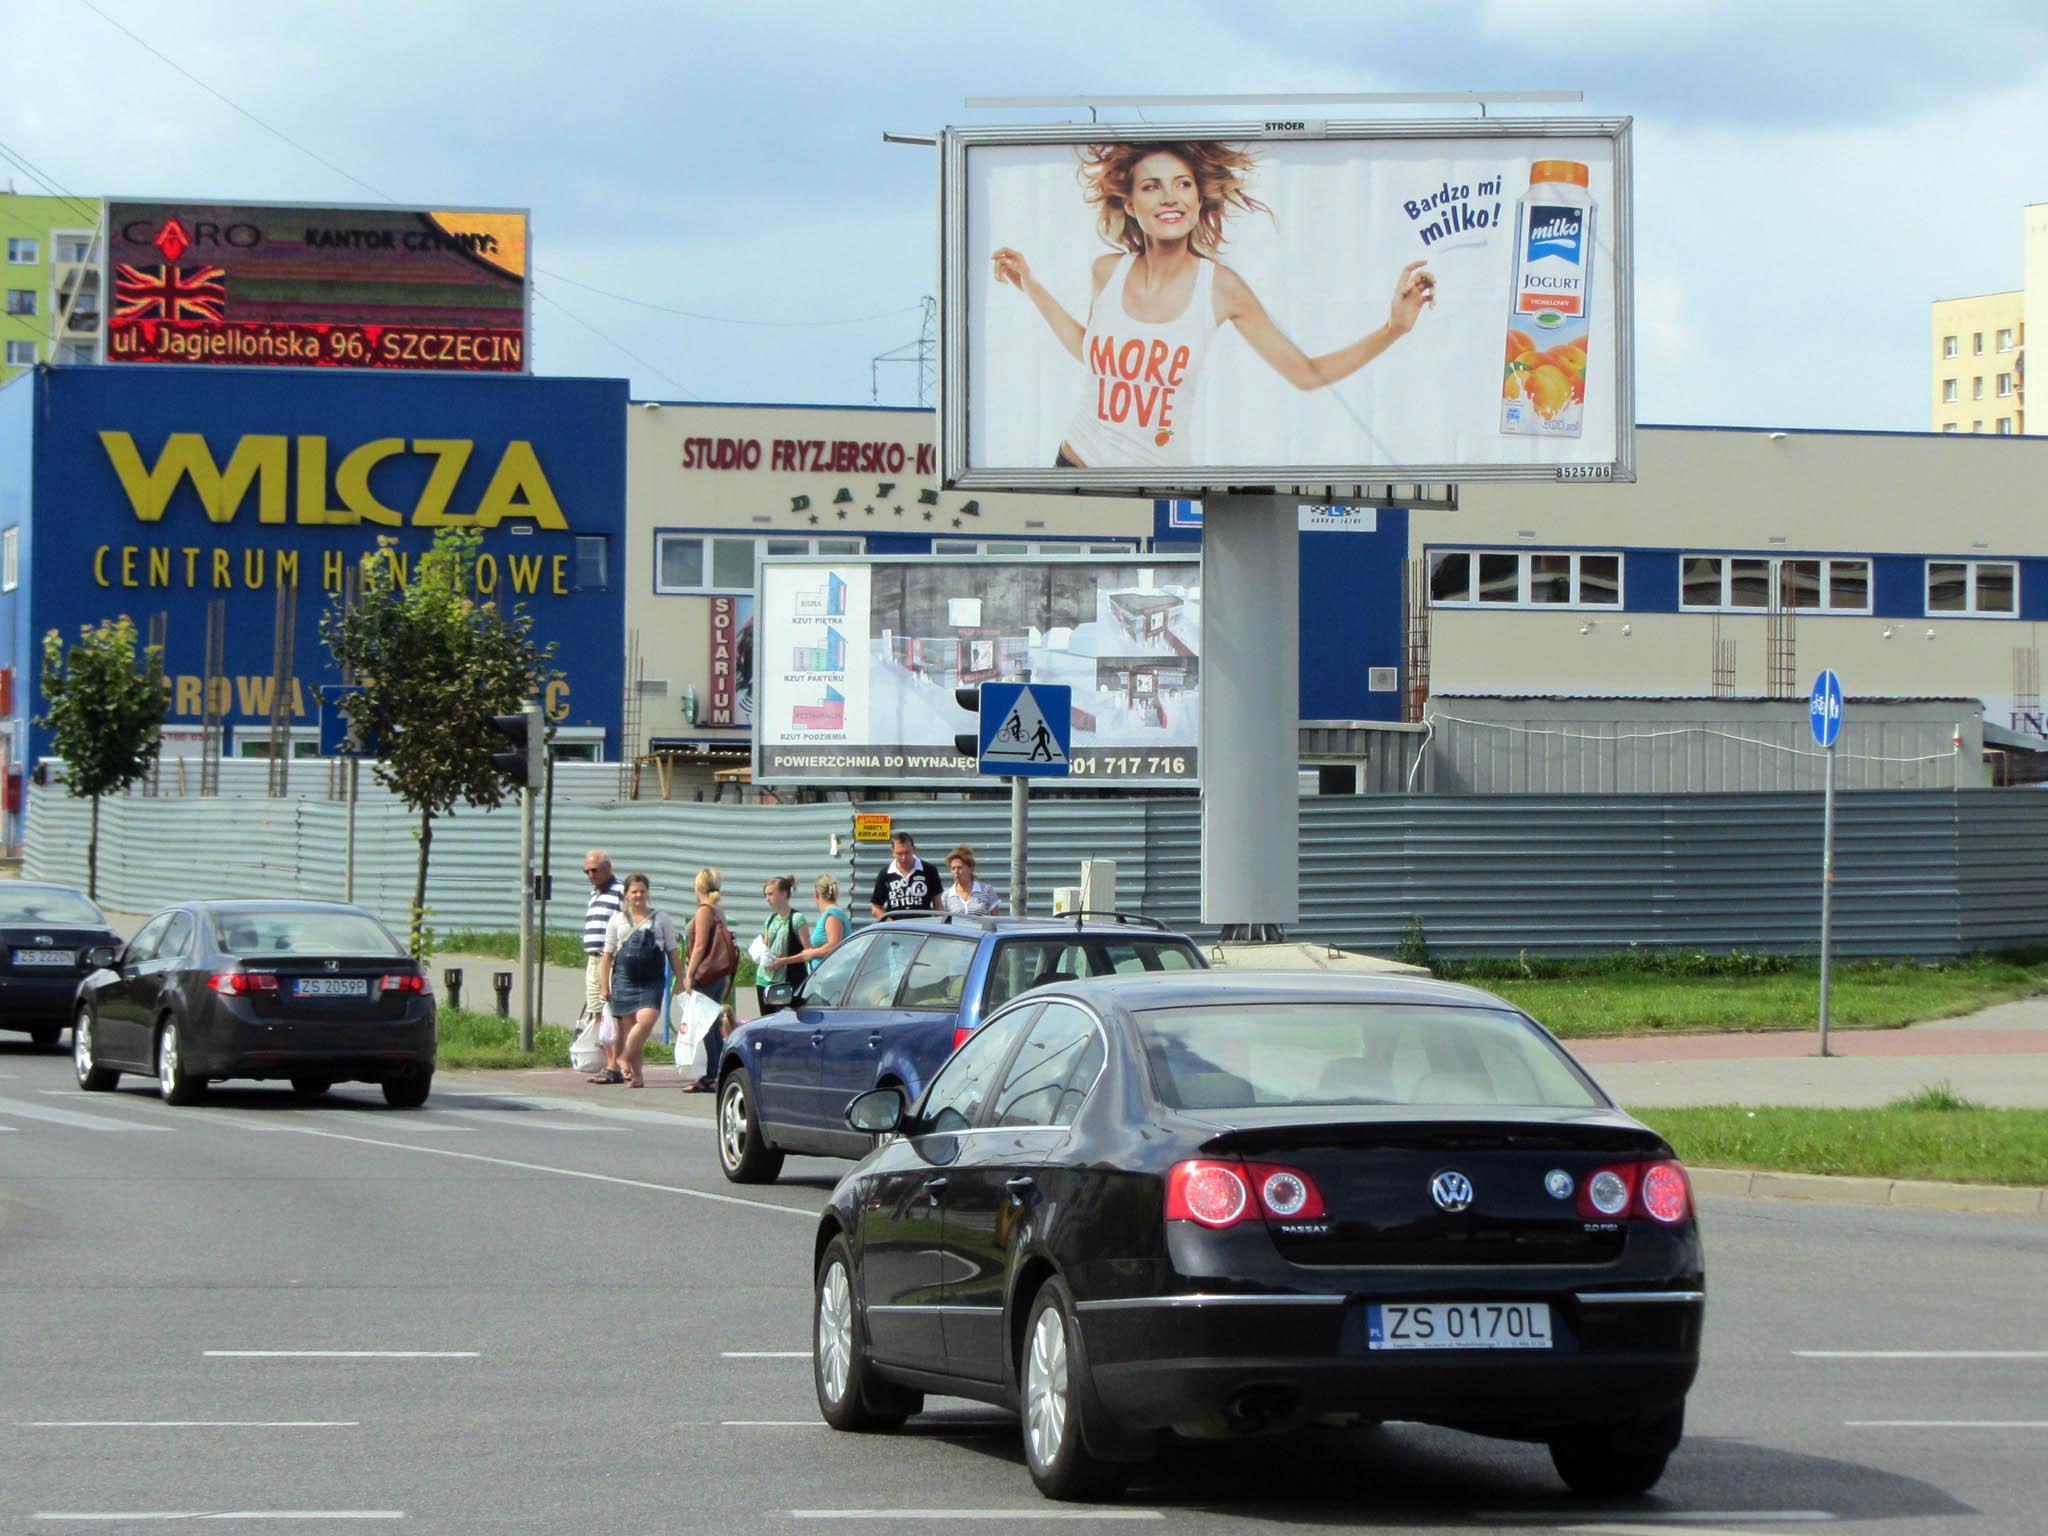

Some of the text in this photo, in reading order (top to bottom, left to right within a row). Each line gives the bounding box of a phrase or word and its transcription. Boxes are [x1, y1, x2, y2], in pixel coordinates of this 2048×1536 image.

[1403, 175, 1501, 220] Bardzo mi
[121, 219, 262, 249] CARO
[1419, 202, 1501, 246] milko!
[1531, 217, 1579, 241] milko
[1523, 273, 1581, 289] JOGURT
[113, 329, 522, 364] ul. Jagiellońska 96, SZCZECIN
[1097, 377, 1176, 428] LOVE
[681, 437, 761, 470] STUDIO
[98, 430, 570, 530] WILCZA
[1556, 466, 1610, 479] 8525706
[93, 545, 300, 590] CENTRUM
[712, 598, 731, 723] SOLARIUM
[774, 755, 881, 768] POWIERZCHNIA
[884, 756, 904, 768] DO
[1104, 757, 1141, 774] 717
[1148, 757, 1185, 774] 716
[302, 981, 320, 993] ZS
[1387, 1306, 1435, 1339] ZS
[1446, 1306, 1545, 1339] 0170L
